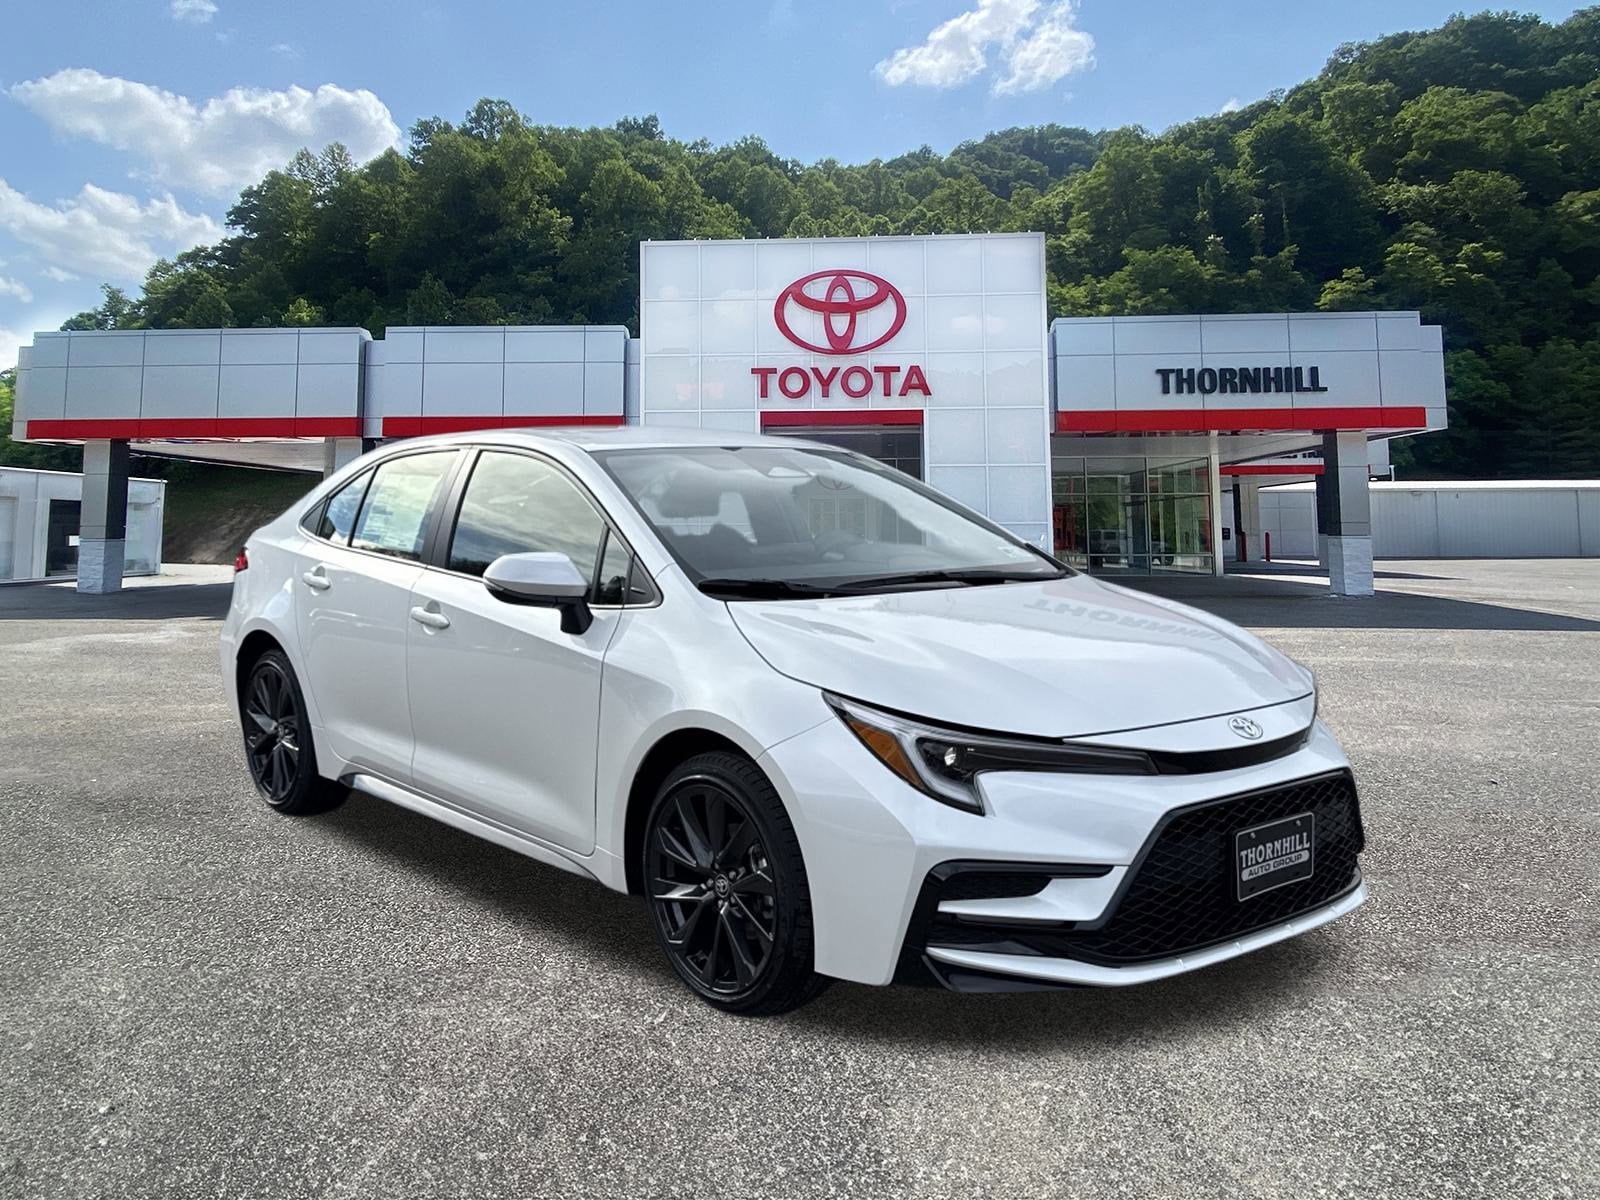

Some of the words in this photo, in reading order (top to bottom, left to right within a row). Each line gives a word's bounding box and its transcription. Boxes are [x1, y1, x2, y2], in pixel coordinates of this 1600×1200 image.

[751, 365, 932, 398] TOYOTA
[1155, 366, 1328, 394] THORNHILL
[1240, 832, 1311, 868] THORNHILL
[1247, 862, 1271, 877] AUTO
[1272, 853, 1304, 869] GROUP
